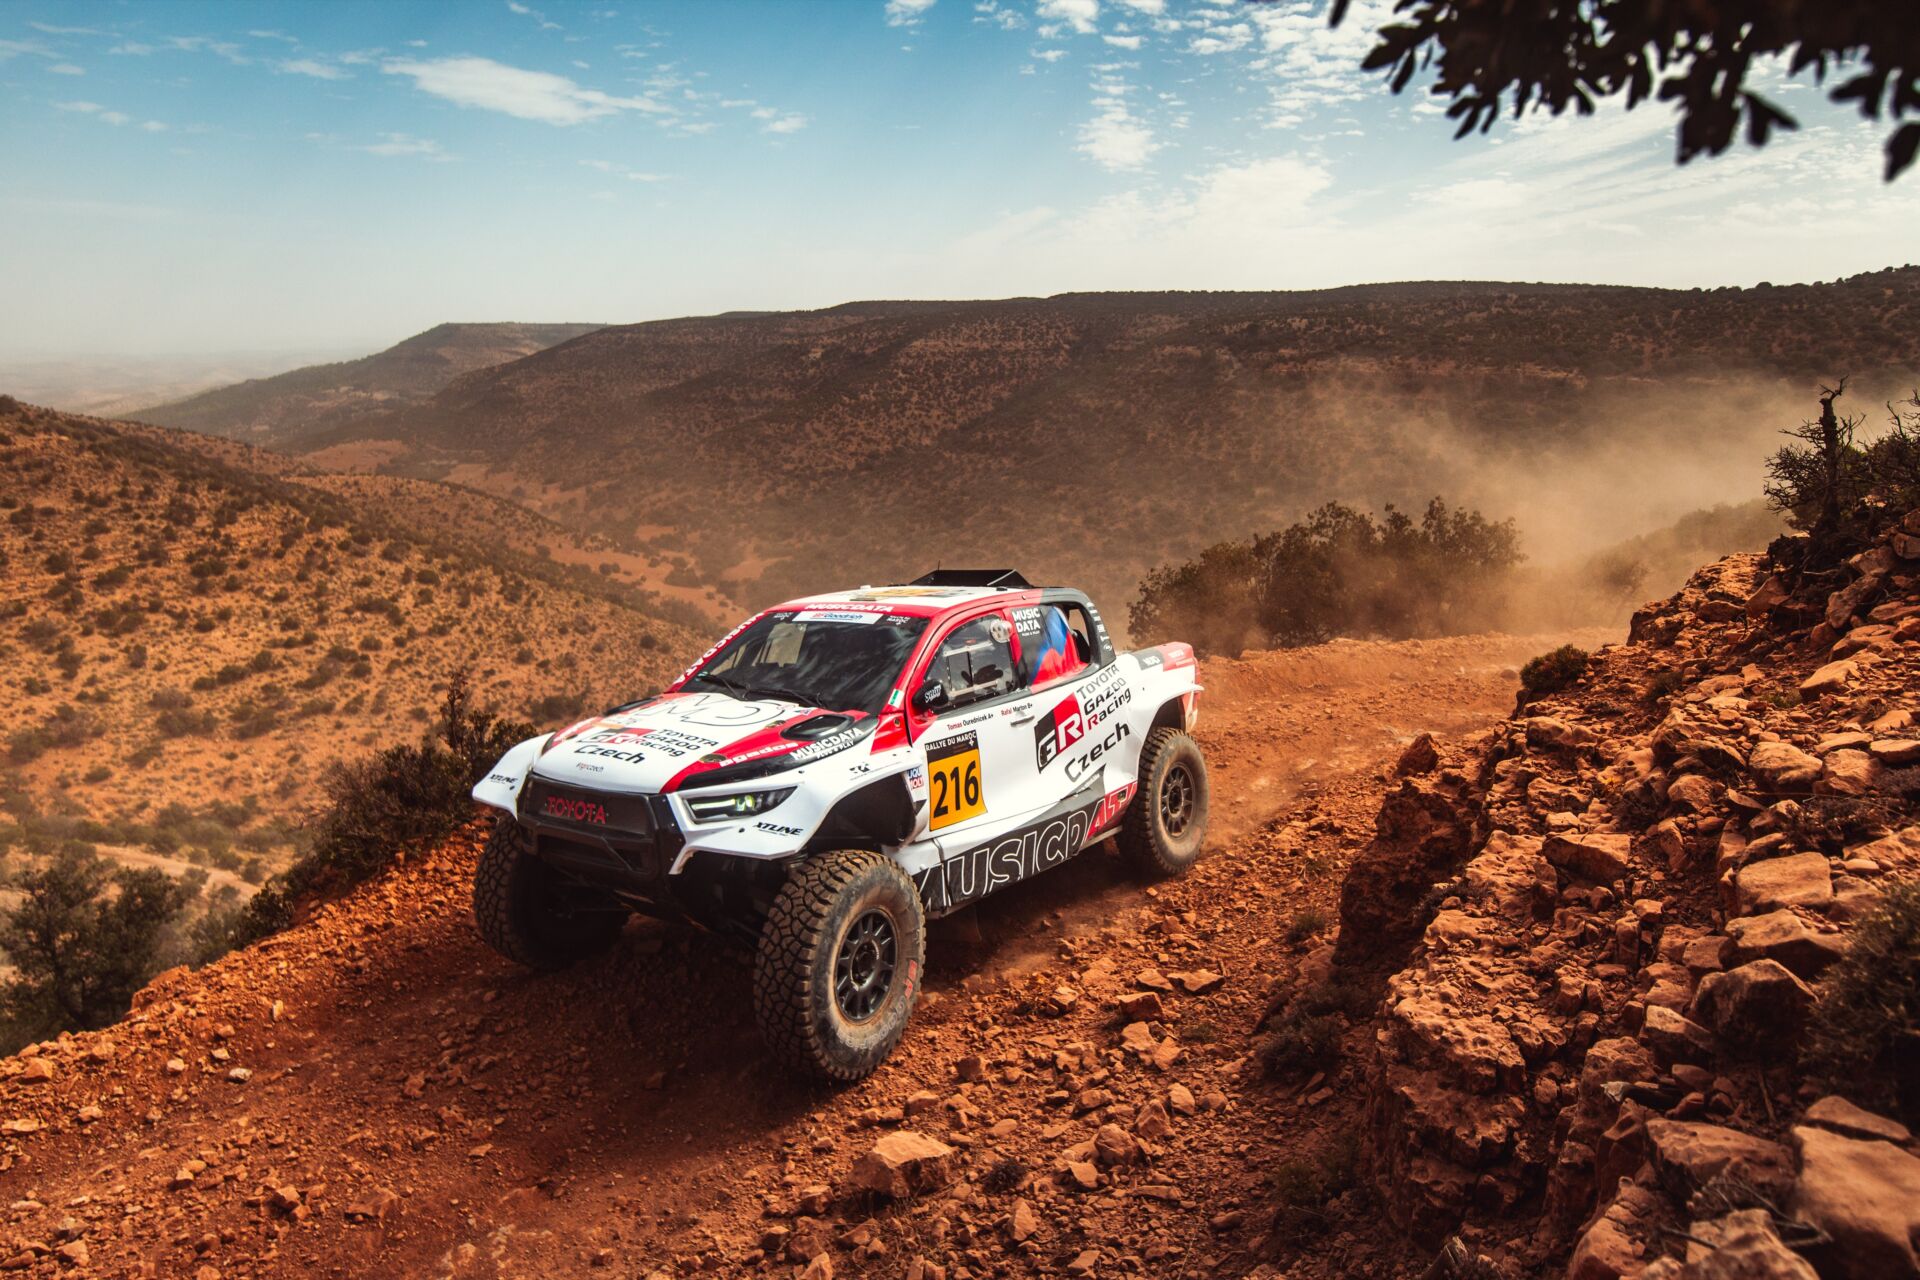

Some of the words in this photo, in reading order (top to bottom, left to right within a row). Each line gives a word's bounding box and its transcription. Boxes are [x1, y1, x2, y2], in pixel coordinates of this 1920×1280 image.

[1011, 607, 1041, 621] MUSIC
[1015, 619, 1041, 632] DATA
[1076, 663, 1120, 700] TOYOTA
[1083, 677, 1127, 716] GAZOO
[1087, 687, 1132, 731] Racing
[657, 728, 719, 748] TOYOTA
[946, 721, 963, 731] Tomas
[573, 744, 646, 764] Czech
[629, 738, 687, 758] Racing
[642, 733, 702, 752] GAZOO
[790, 727, 866, 761] MUSICDATA
[925, 740, 947, 752] RALLYE
[947, 737, 956, 746] DU
[956, 731, 977, 744] MAROC
[1037, 711, 1084, 774] GR
[1064, 721, 1131, 783] Czech
[932, 760, 979, 818] 216
[546, 795, 607, 825] TOYOTA
